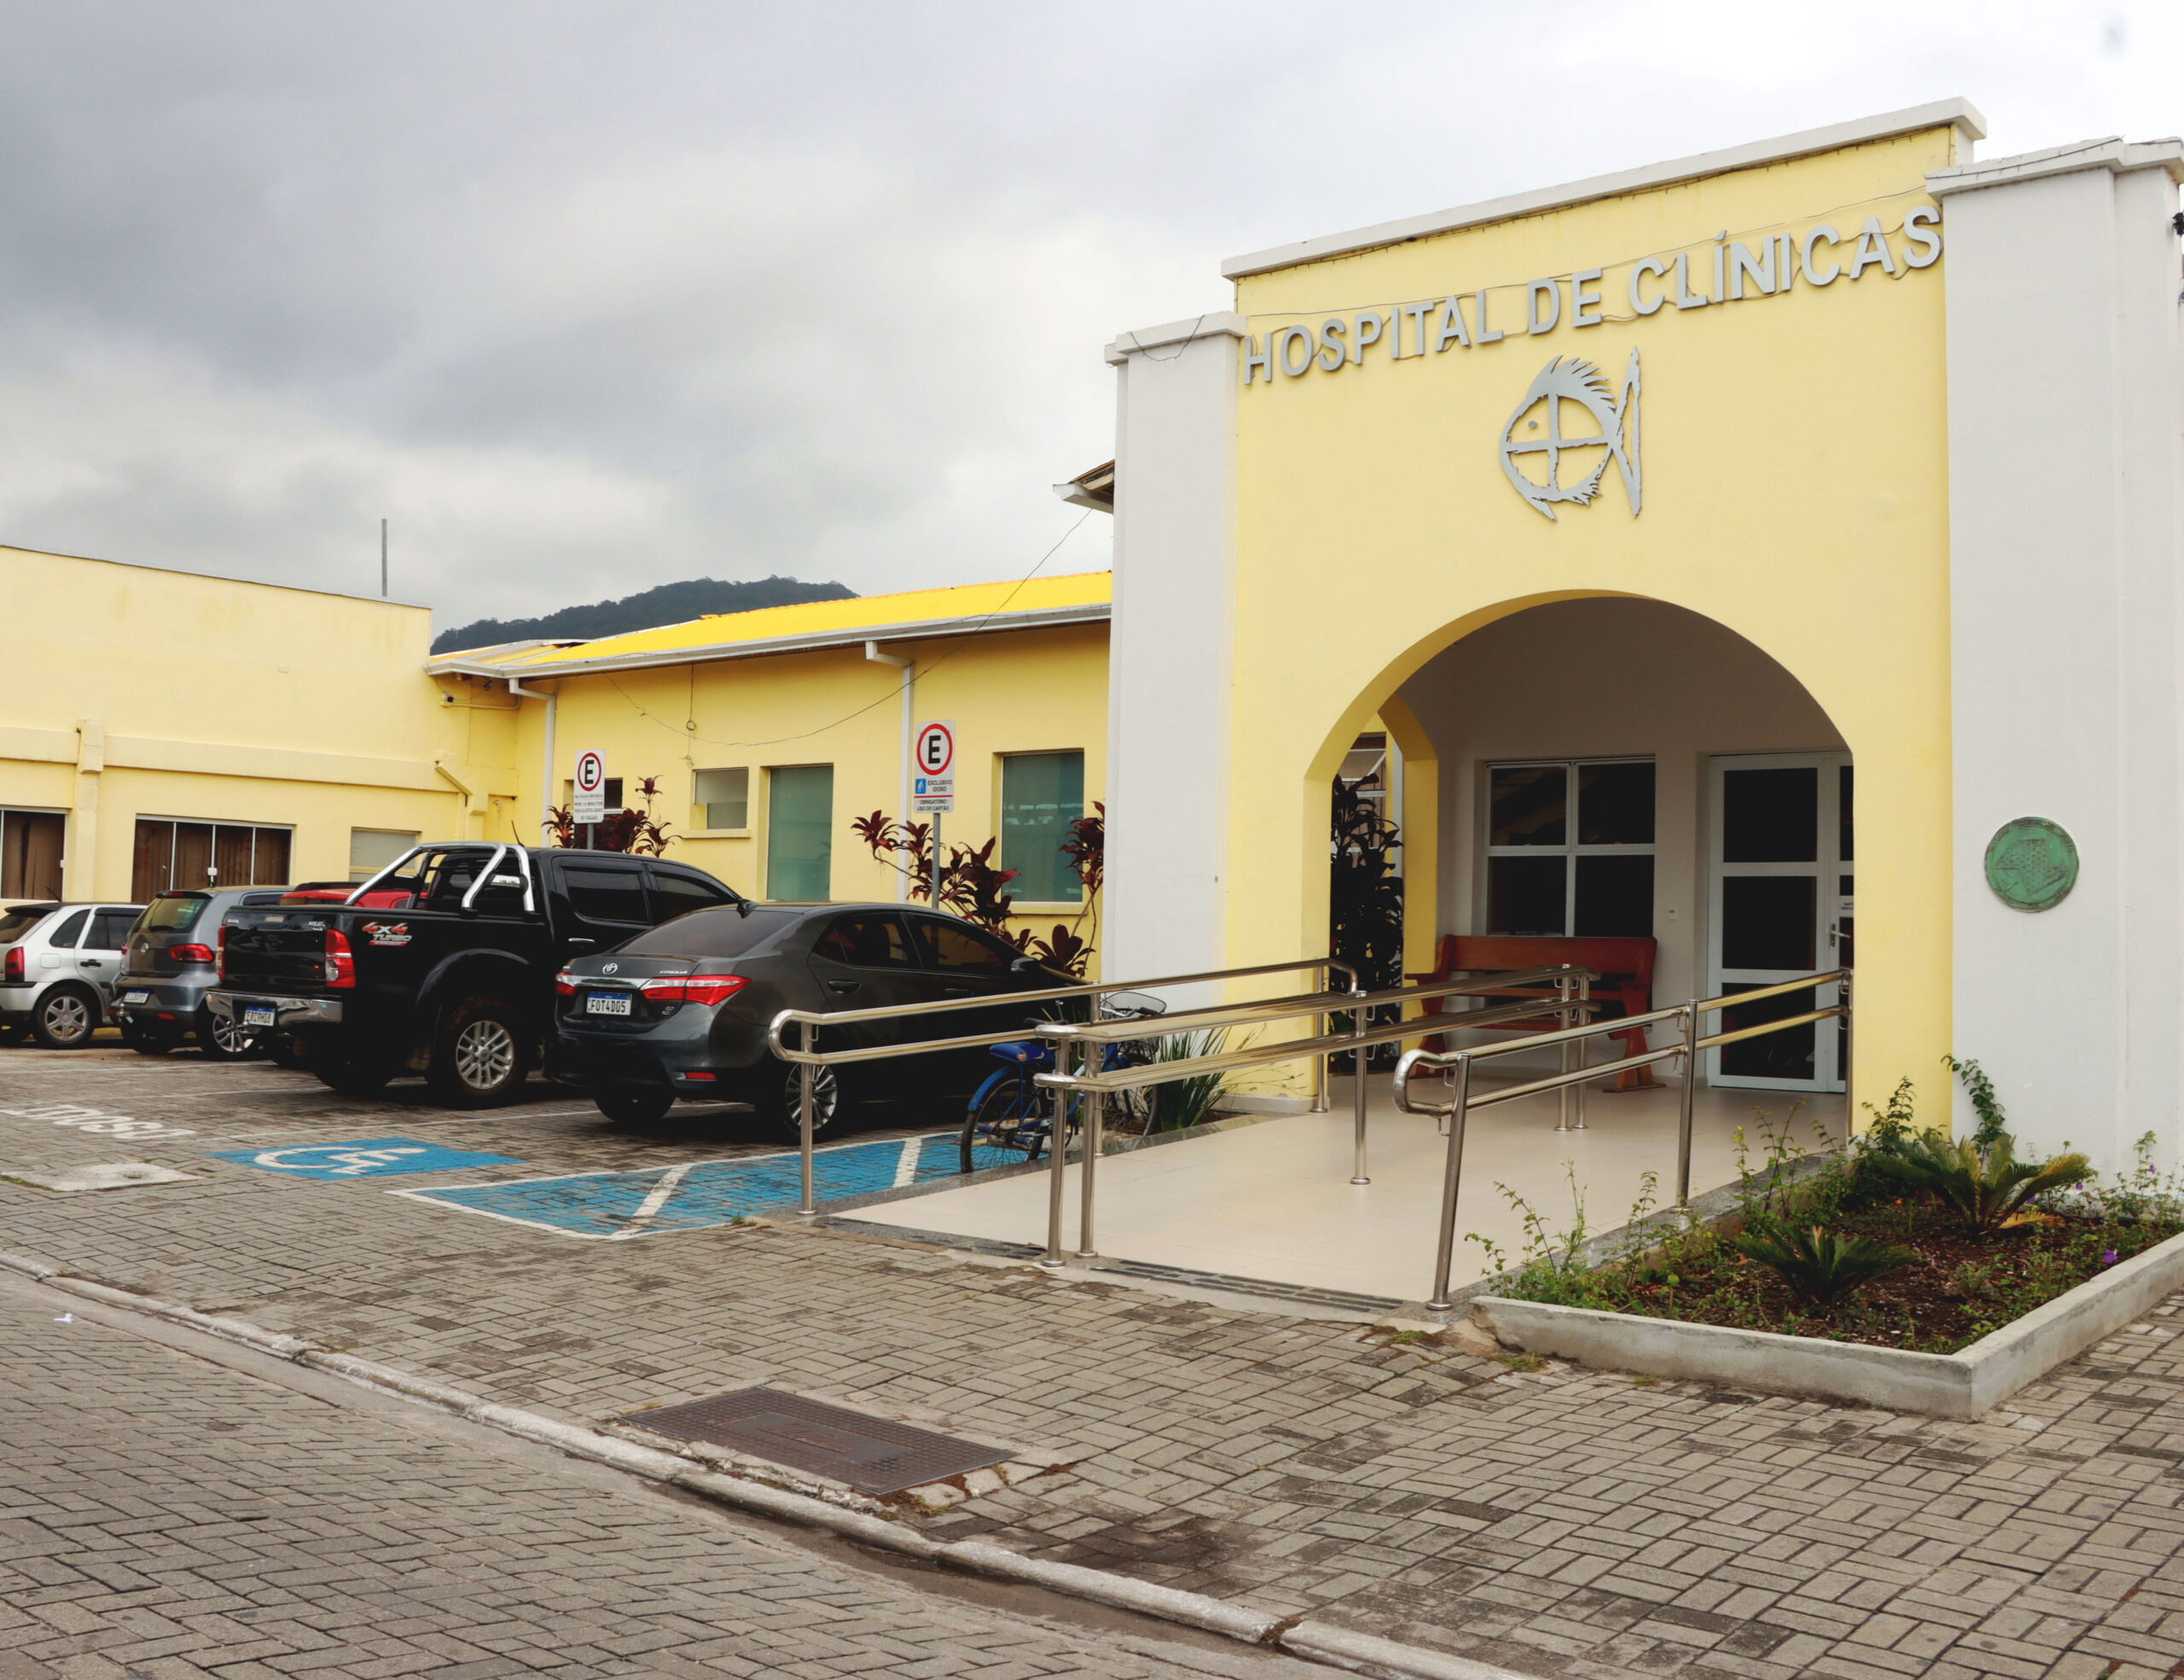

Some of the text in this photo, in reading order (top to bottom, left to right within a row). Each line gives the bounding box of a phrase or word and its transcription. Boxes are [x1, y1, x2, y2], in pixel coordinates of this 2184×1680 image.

[1243, 205, 1943, 385] HOSPITAL DE CLÍNICAS
[928, 735, 941, 764] E
[584, 760, 595, 784] E
[373, 933, 413, 942] TURBO
